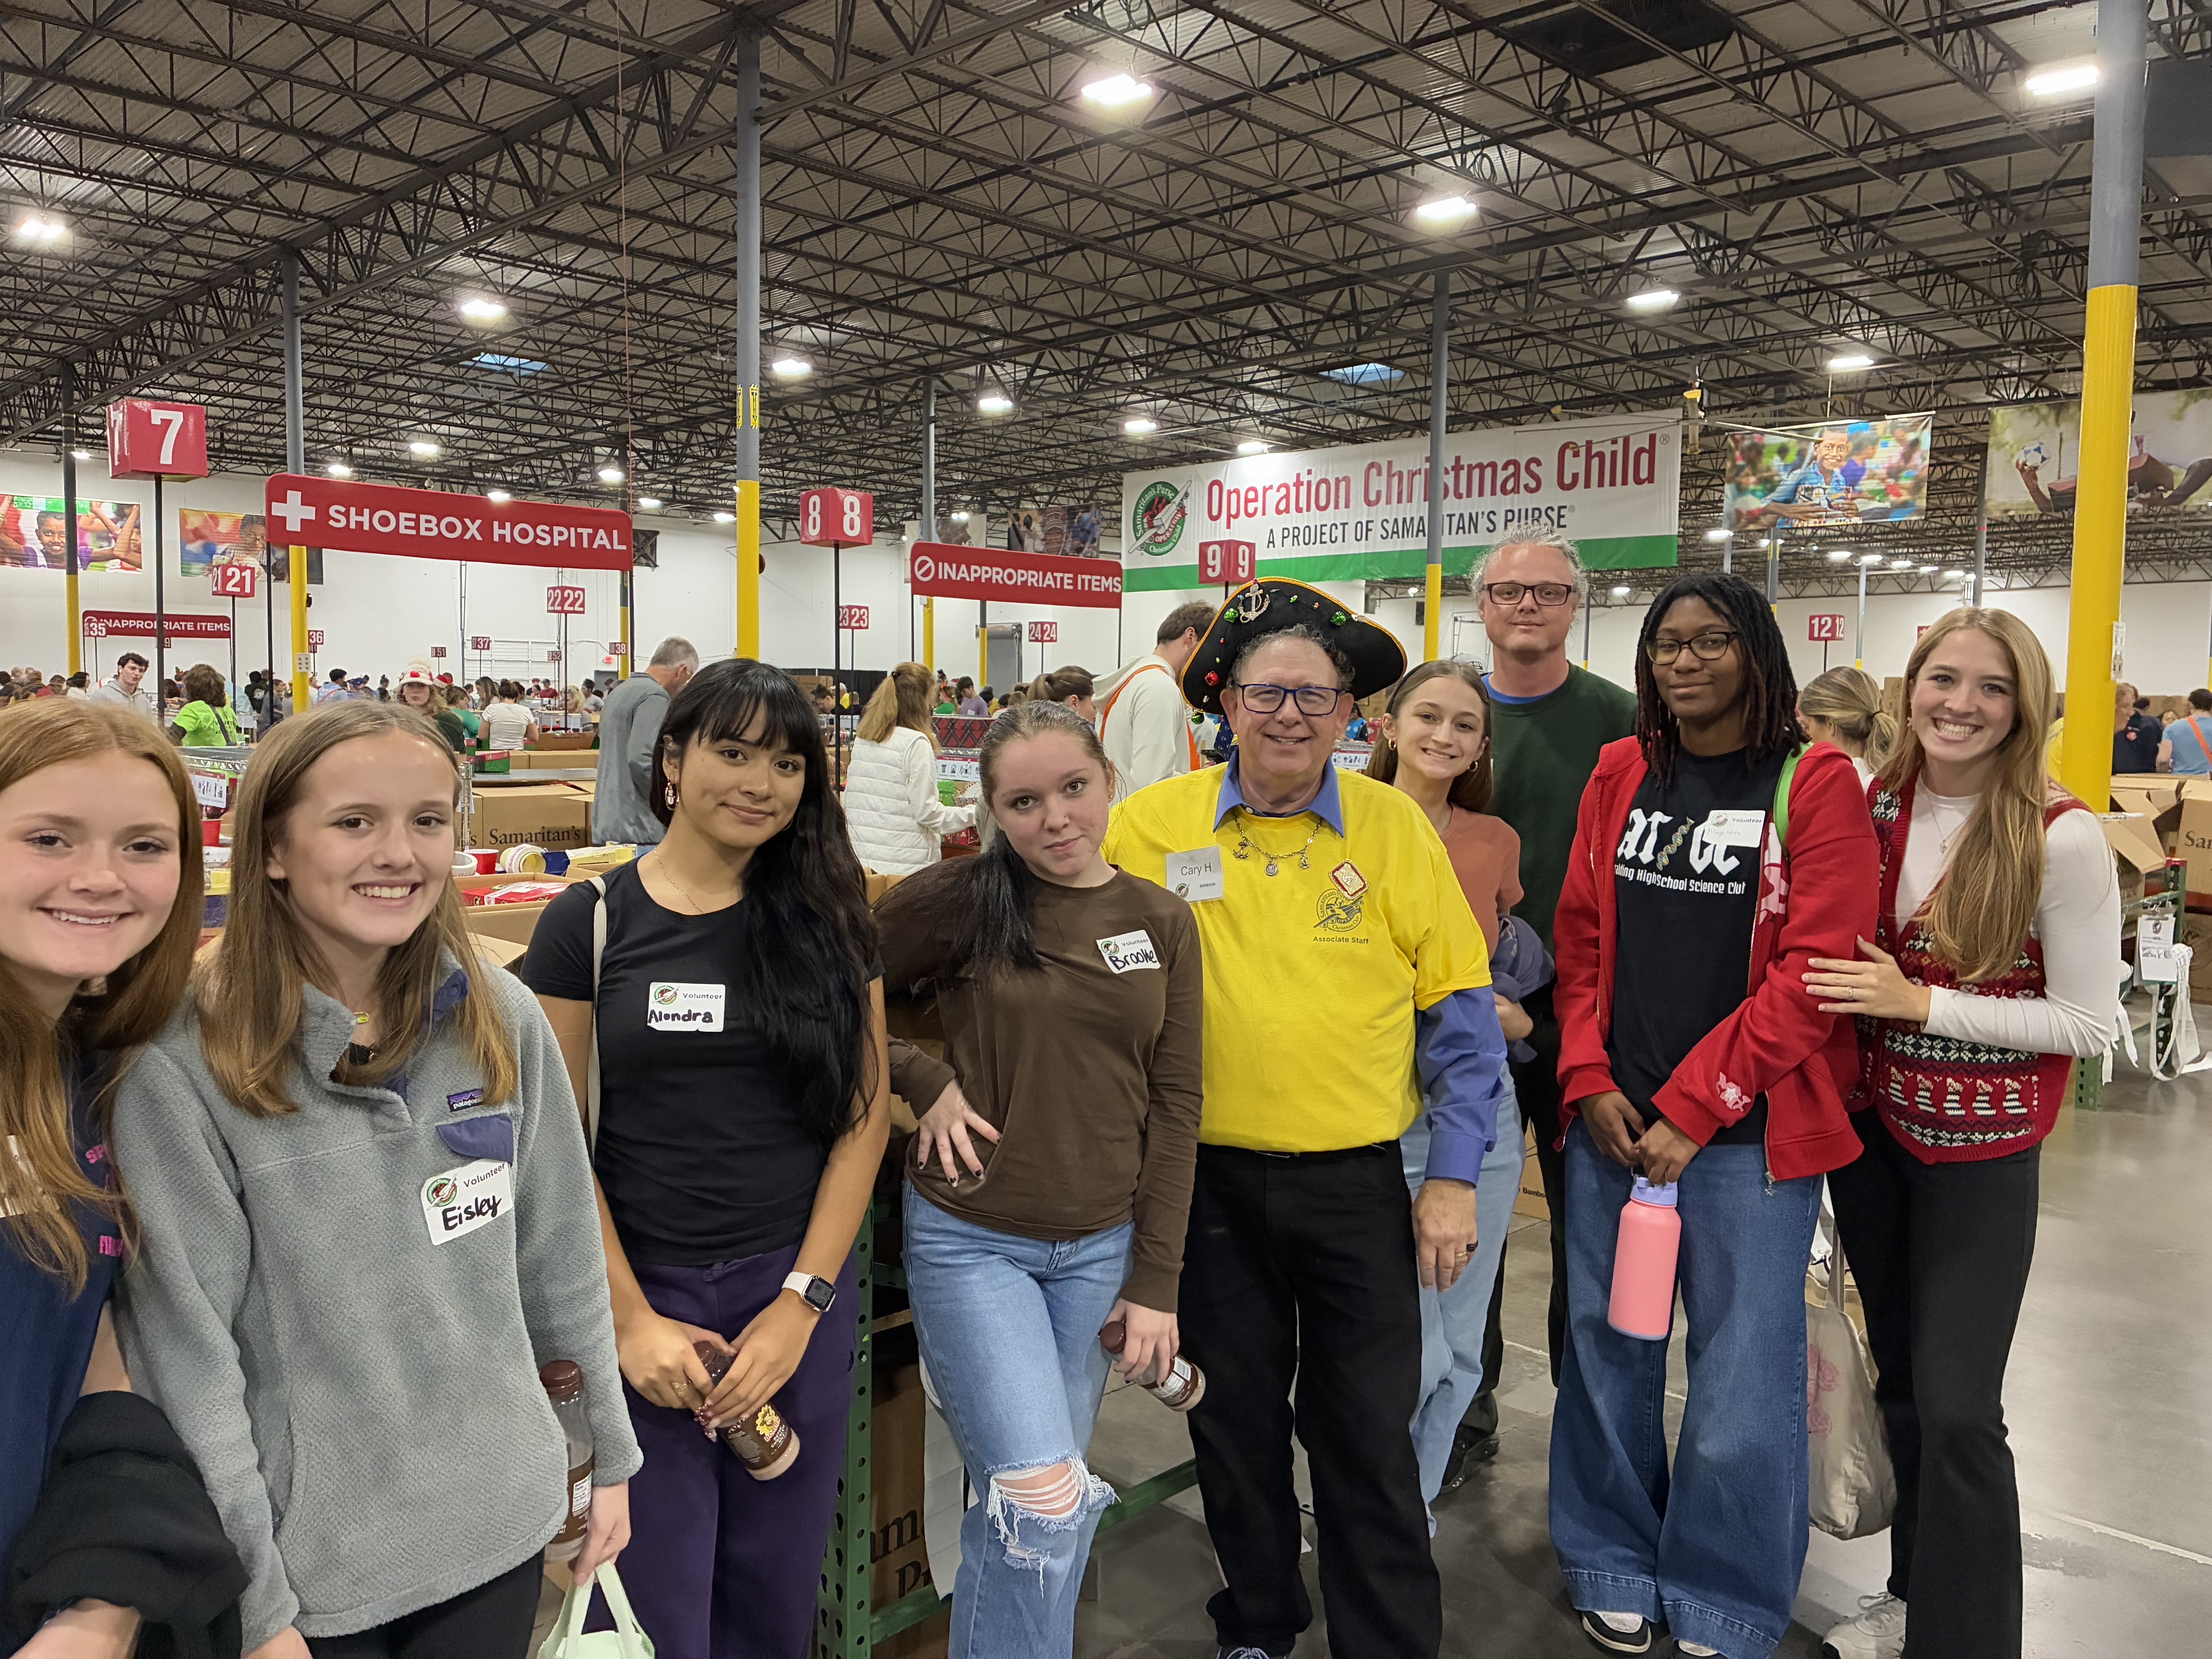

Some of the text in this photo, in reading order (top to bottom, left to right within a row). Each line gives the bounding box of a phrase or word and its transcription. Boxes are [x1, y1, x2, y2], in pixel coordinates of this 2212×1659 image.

[151, 409, 184, 465] 7
[1157, 484, 1175, 499] Purse
[1207, 469, 1350, 529] Operation
[808, 495, 821, 536] 8
[843, 495, 860, 536] 8
[328, 504, 627, 550] SHOEBOX HOSPITAL
[1155, 512, 1182, 543] OPERATION
[1267, 528, 1276, 549] A
[1282, 522, 1348, 548] PROJECT
[1355, 520, 1374, 541] OF
[1380, 509, 1497, 540] SAMAITAN'S
[1149, 525, 1182, 553] Christmas Child
[1207, 544, 1221, 577] 9
[1238, 545, 1249, 578] 9
[212, 567, 221, 591] 21
[226, 567, 251, 593] 21
[938, 561, 1121, 593] INAPPROPRIATE ITEMS
[548, 589, 562, 610] 22
[563, 589, 584, 611] 22
[100, 619, 230, 631] NAPPRORIATE ITEMS
[851, 608, 868, 627] 23
[1811, 617, 1832, 638] 12
[1836, 617, 1844, 637] 12
[90, 622, 106, 636] 35
[309, 631, 323, 644] 36
[1029, 623, 1041, 640] 24
[1043, 623, 1056, 640] 24
[437, 647, 445, 657] 51
[477, 637, 489, 649] 37
[615, 643, 627, 654] 38
[553, 651, 561, 660] 52
[489, 825, 580, 845] Samaritan's
[1181, 862, 1212, 876] Cary H
[1688, 879, 1725, 894] Science
[1121, 938, 1149, 947] Volunteer
[1108, 948, 1158, 971] Brooke
[648, 1009, 714, 1024] Alondra
[464, 1162, 505, 1188] Volunteer
[441, 1194, 502, 1231] Eisley
